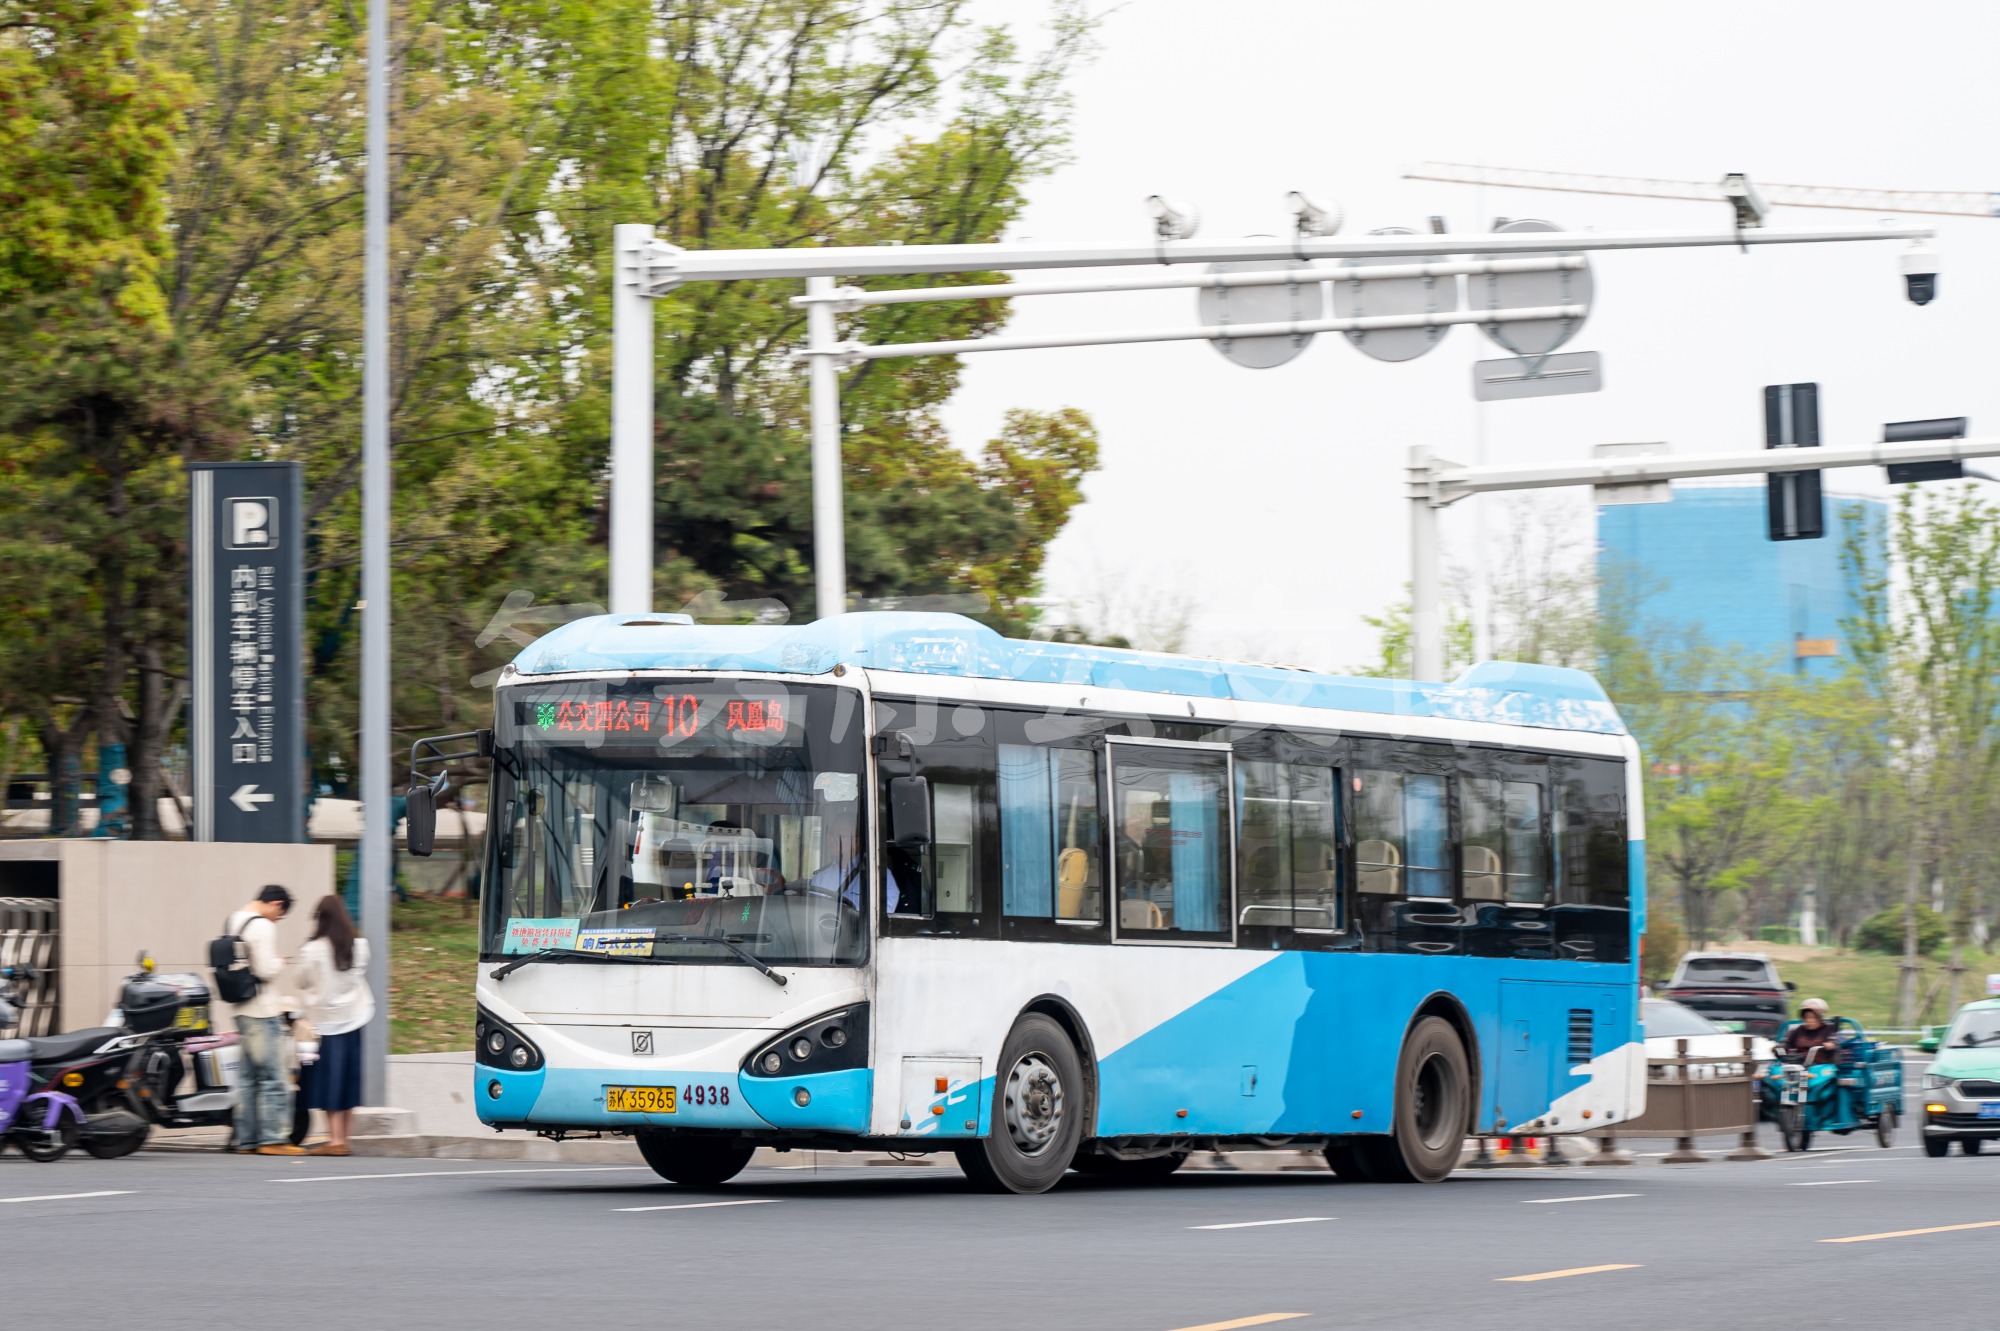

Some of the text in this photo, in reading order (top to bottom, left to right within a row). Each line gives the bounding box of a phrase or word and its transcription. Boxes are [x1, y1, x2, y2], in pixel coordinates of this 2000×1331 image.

[229, 564, 258, 764] 内部车辆停车入口
[557, 694, 784, 737] 公交四公司 10 凤凰岛
[683, 1085, 730, 1106] 4938
